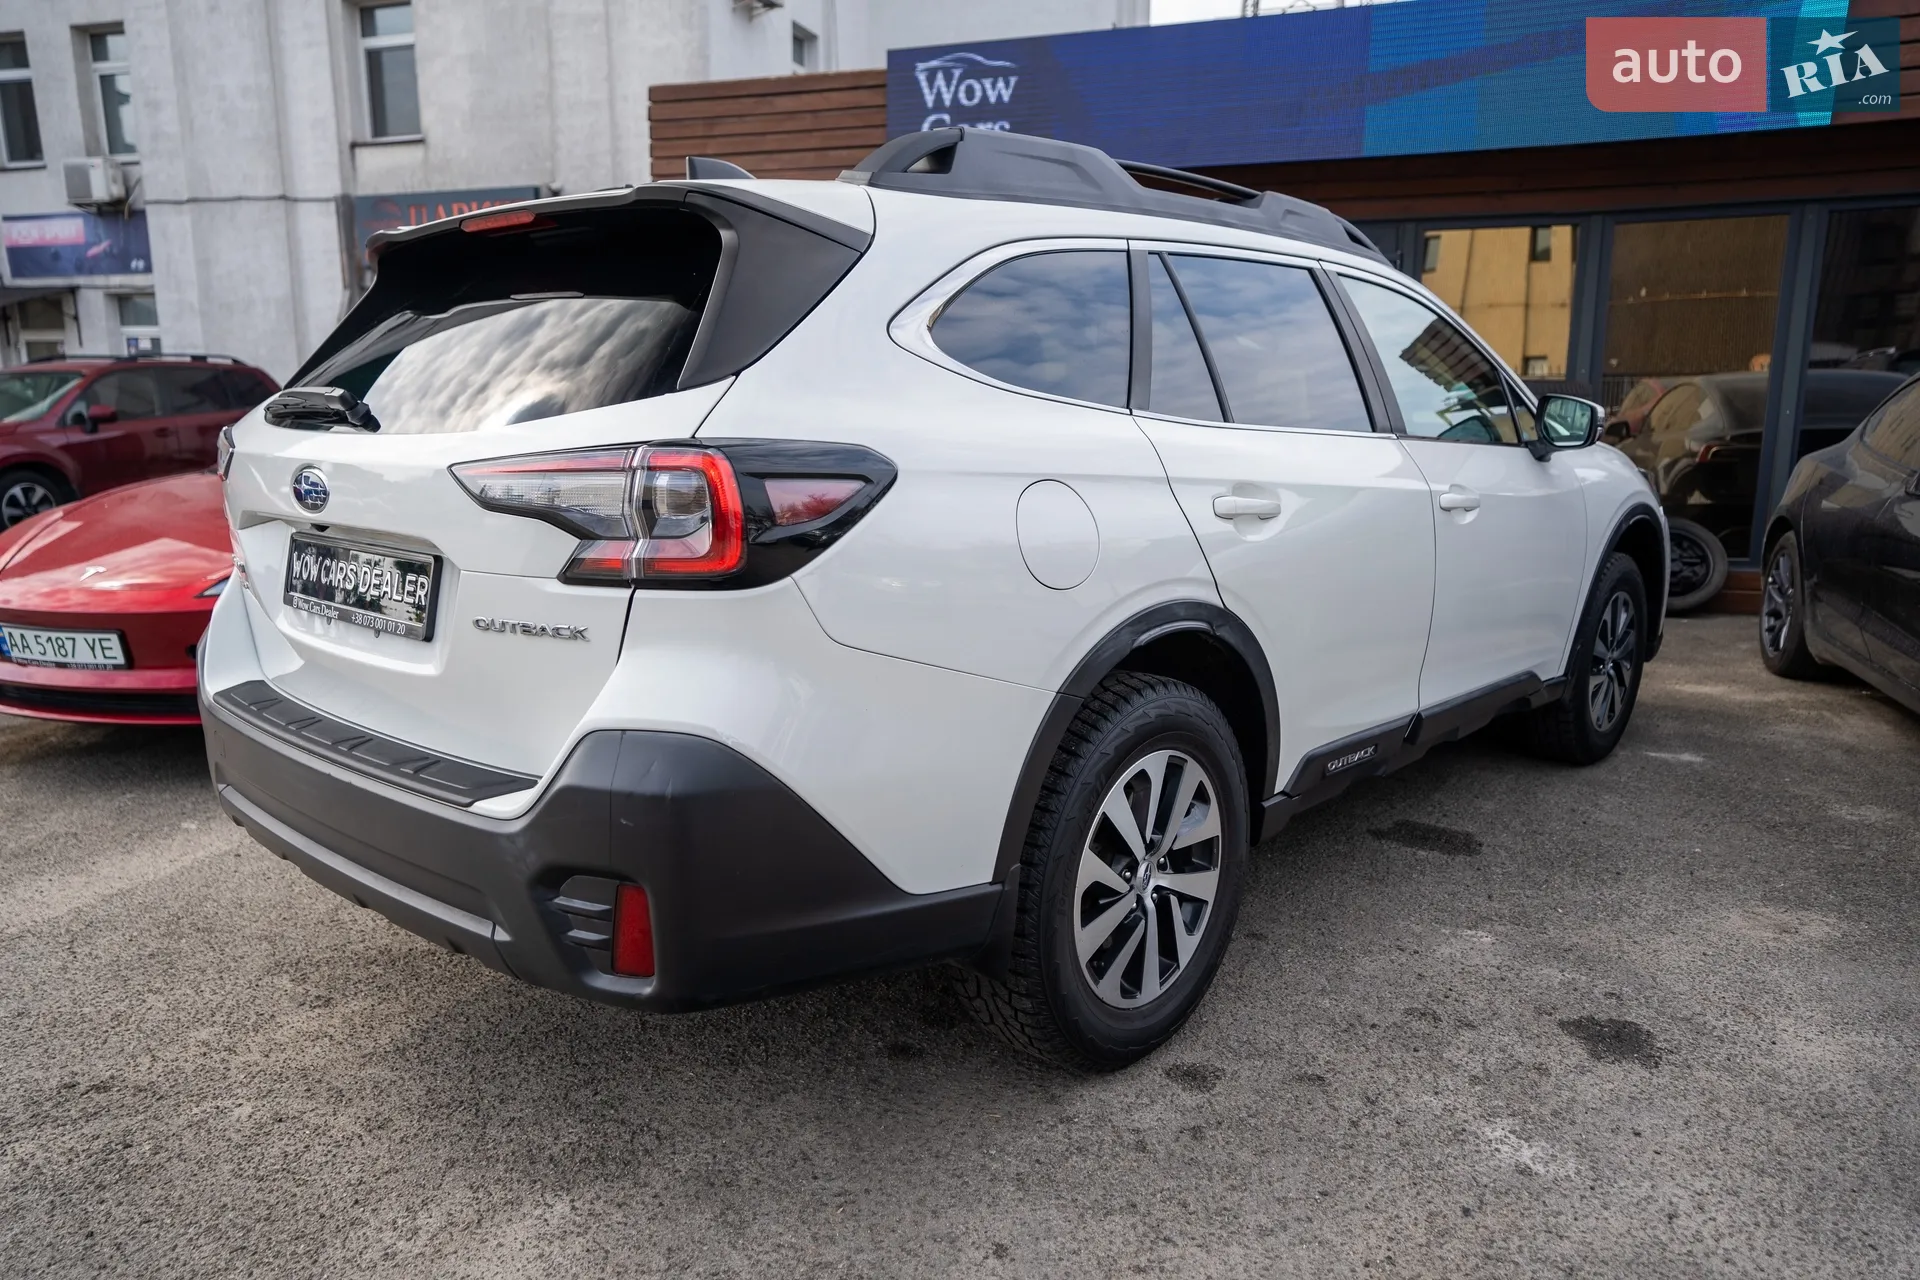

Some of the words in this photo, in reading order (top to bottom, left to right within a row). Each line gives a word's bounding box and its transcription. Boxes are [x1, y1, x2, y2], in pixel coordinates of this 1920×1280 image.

[915, 68, 1019, 109] Wow
[293, 552, 322, 583] WOW
[320, 558, 357, 591] CARS
[358, 565, 430, 605] DEALER
[351, 613, 363, 624] +38
[363, 615, 375, 628] 073
[375, 617, 387, 631] 001
[387, 620, 396, 632] 01
[396, 623, 406, 635] 20
[472, 616, 591, 642] OUTBACK
[8, 631, 33, 655] AA
[34, 635, 76, 658] 5187
[84, 637, 117, 660] YE
[1327, 745, 1375, 771] OUTBACK
